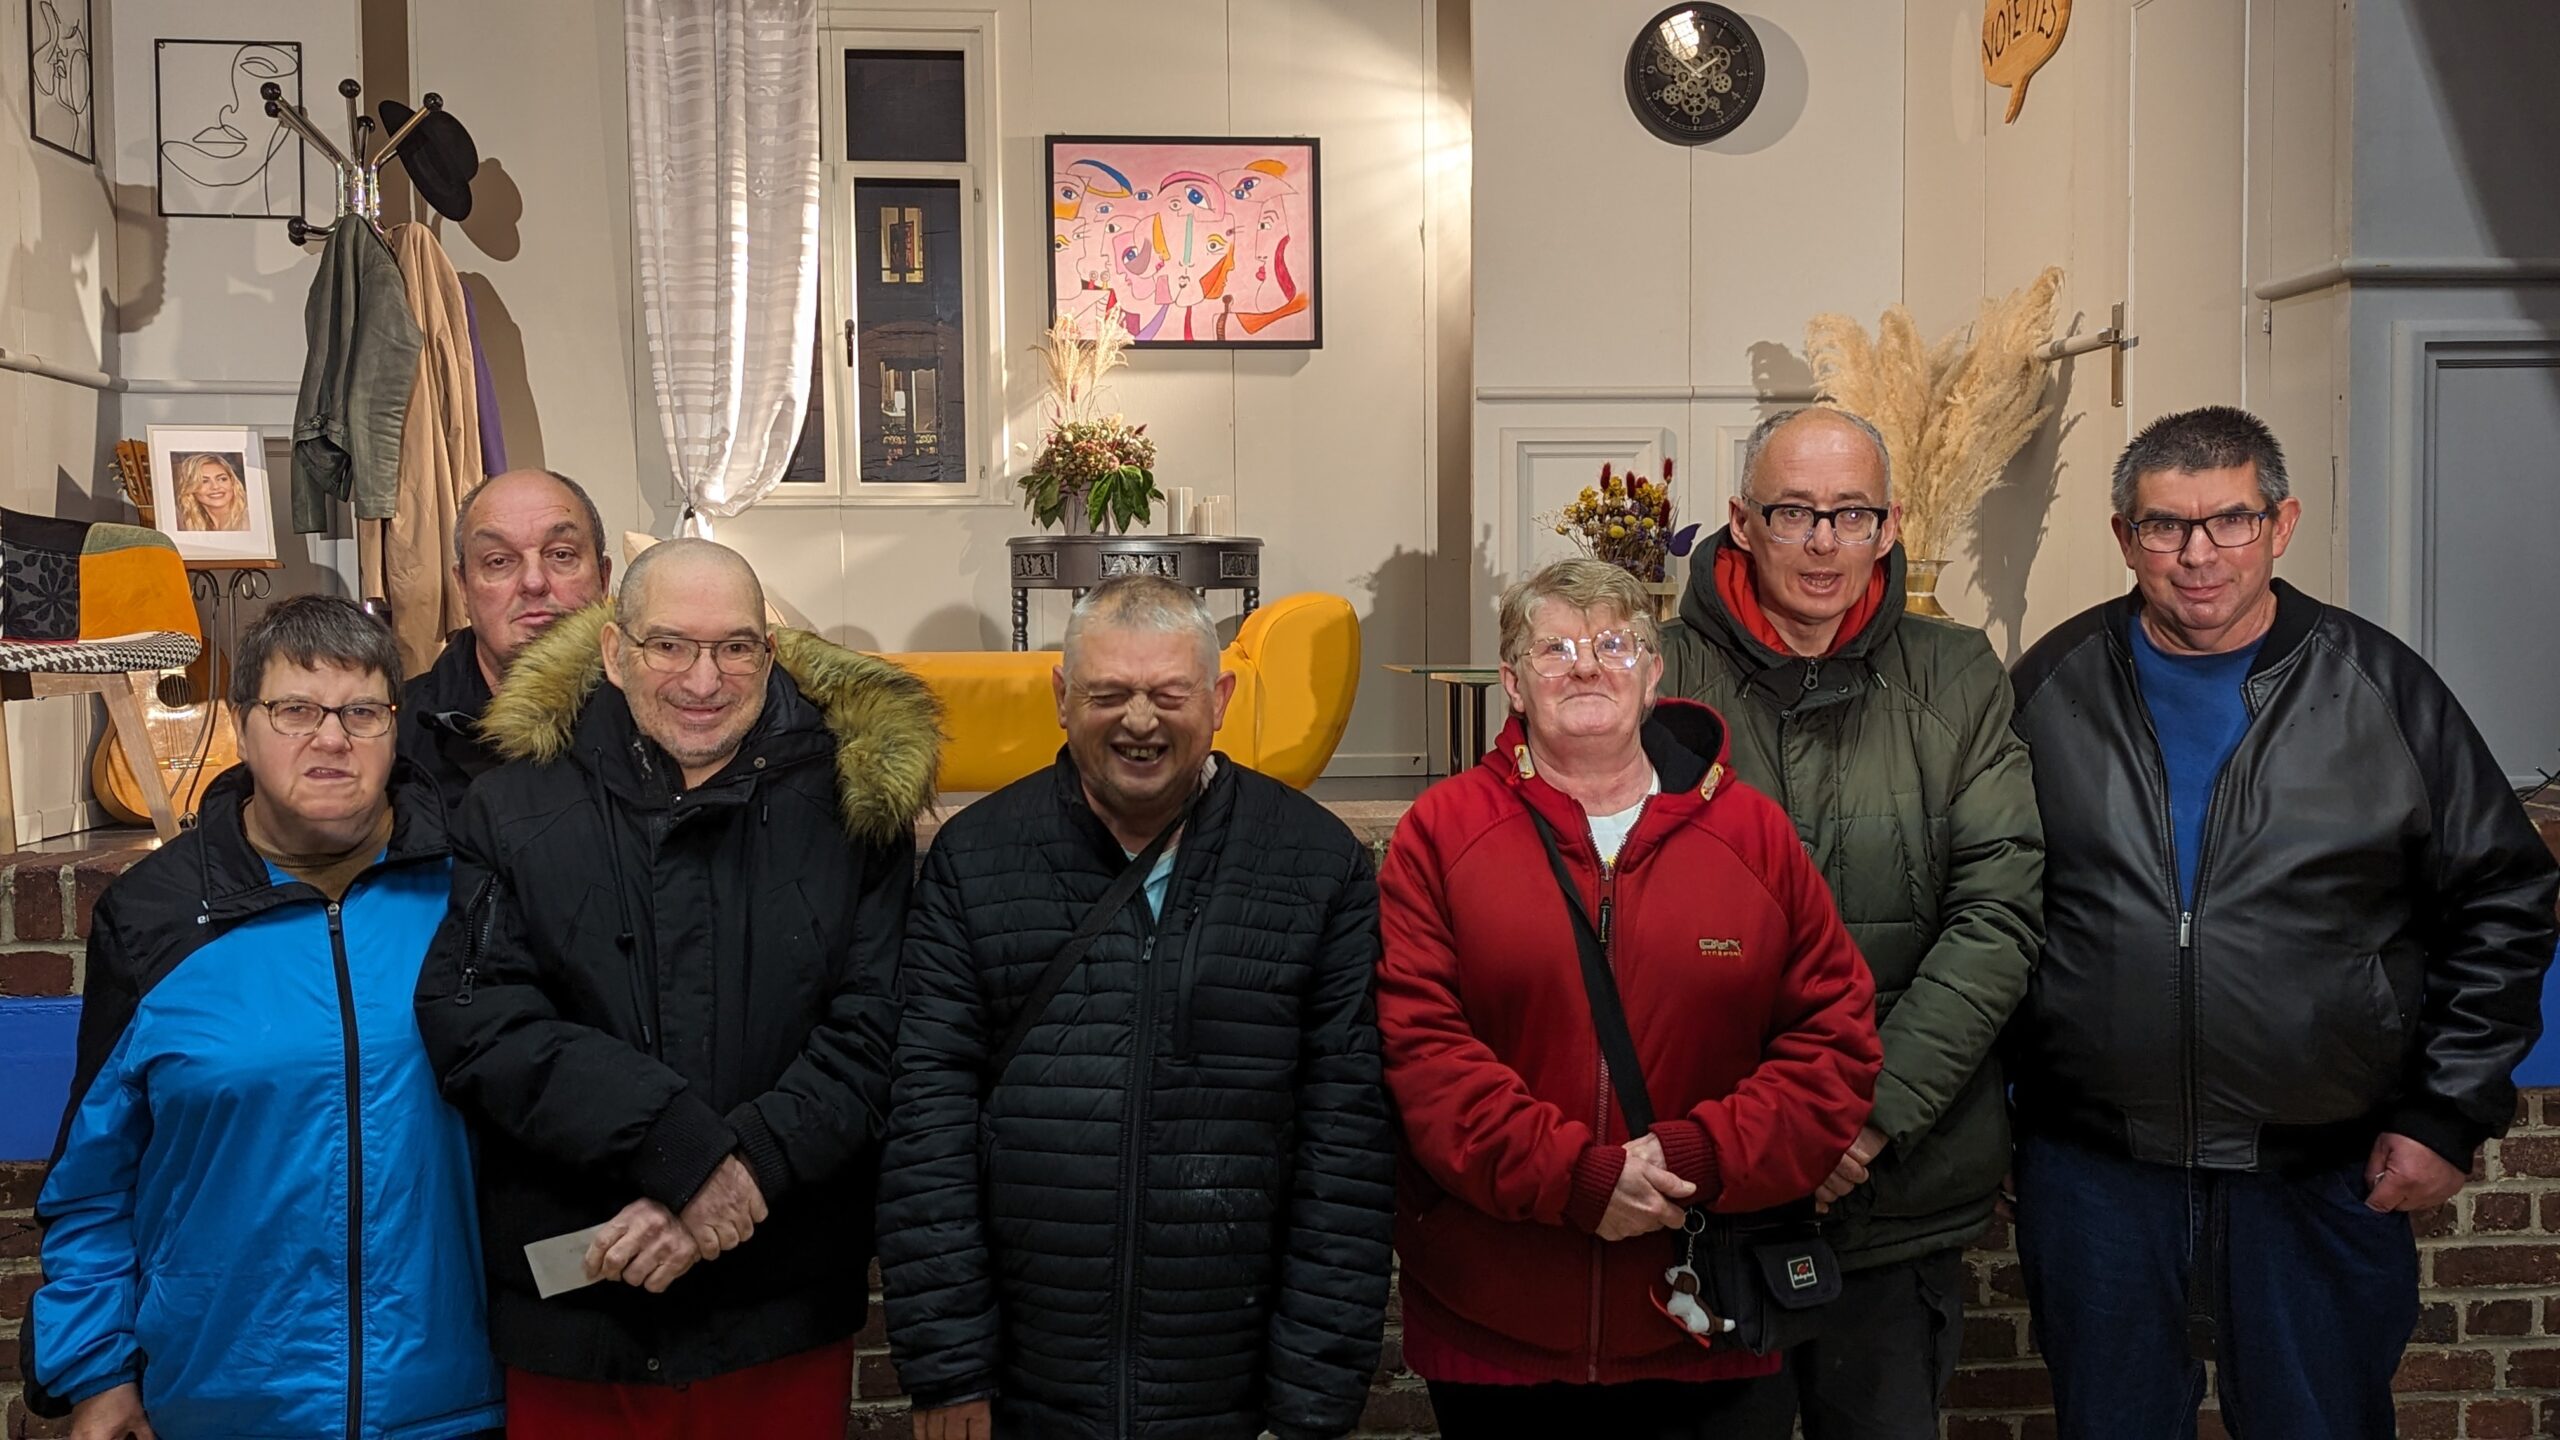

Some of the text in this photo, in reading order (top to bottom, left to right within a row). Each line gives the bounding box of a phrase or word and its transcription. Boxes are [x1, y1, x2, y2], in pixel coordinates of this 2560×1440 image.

[1730, 45, 1741, 55] 2
[1737, 69, 1747, 77] 3
[1652, 89, 1663, 101] 8
[1731, 91, 1741, 100] 4
[1668, 106, 1680, 116] 7
[1692, 114, 1700, 125] 6
